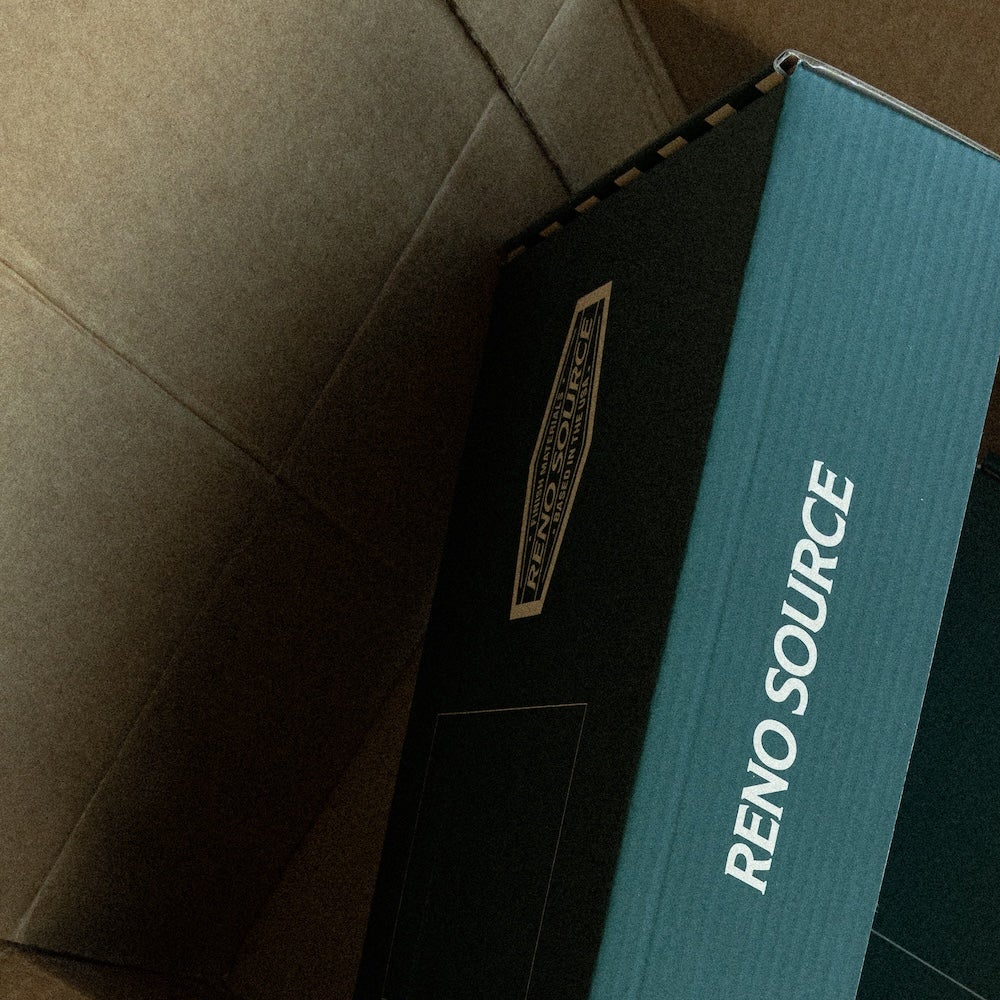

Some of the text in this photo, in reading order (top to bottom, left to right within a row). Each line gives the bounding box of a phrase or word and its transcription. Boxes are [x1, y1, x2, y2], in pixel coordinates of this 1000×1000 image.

[526, 317, 594, 592] RENO SOURCE
[553, 376, 590, 523] BASED IN THE USA
[724, 459, 856, 896] RENO SOURCE
